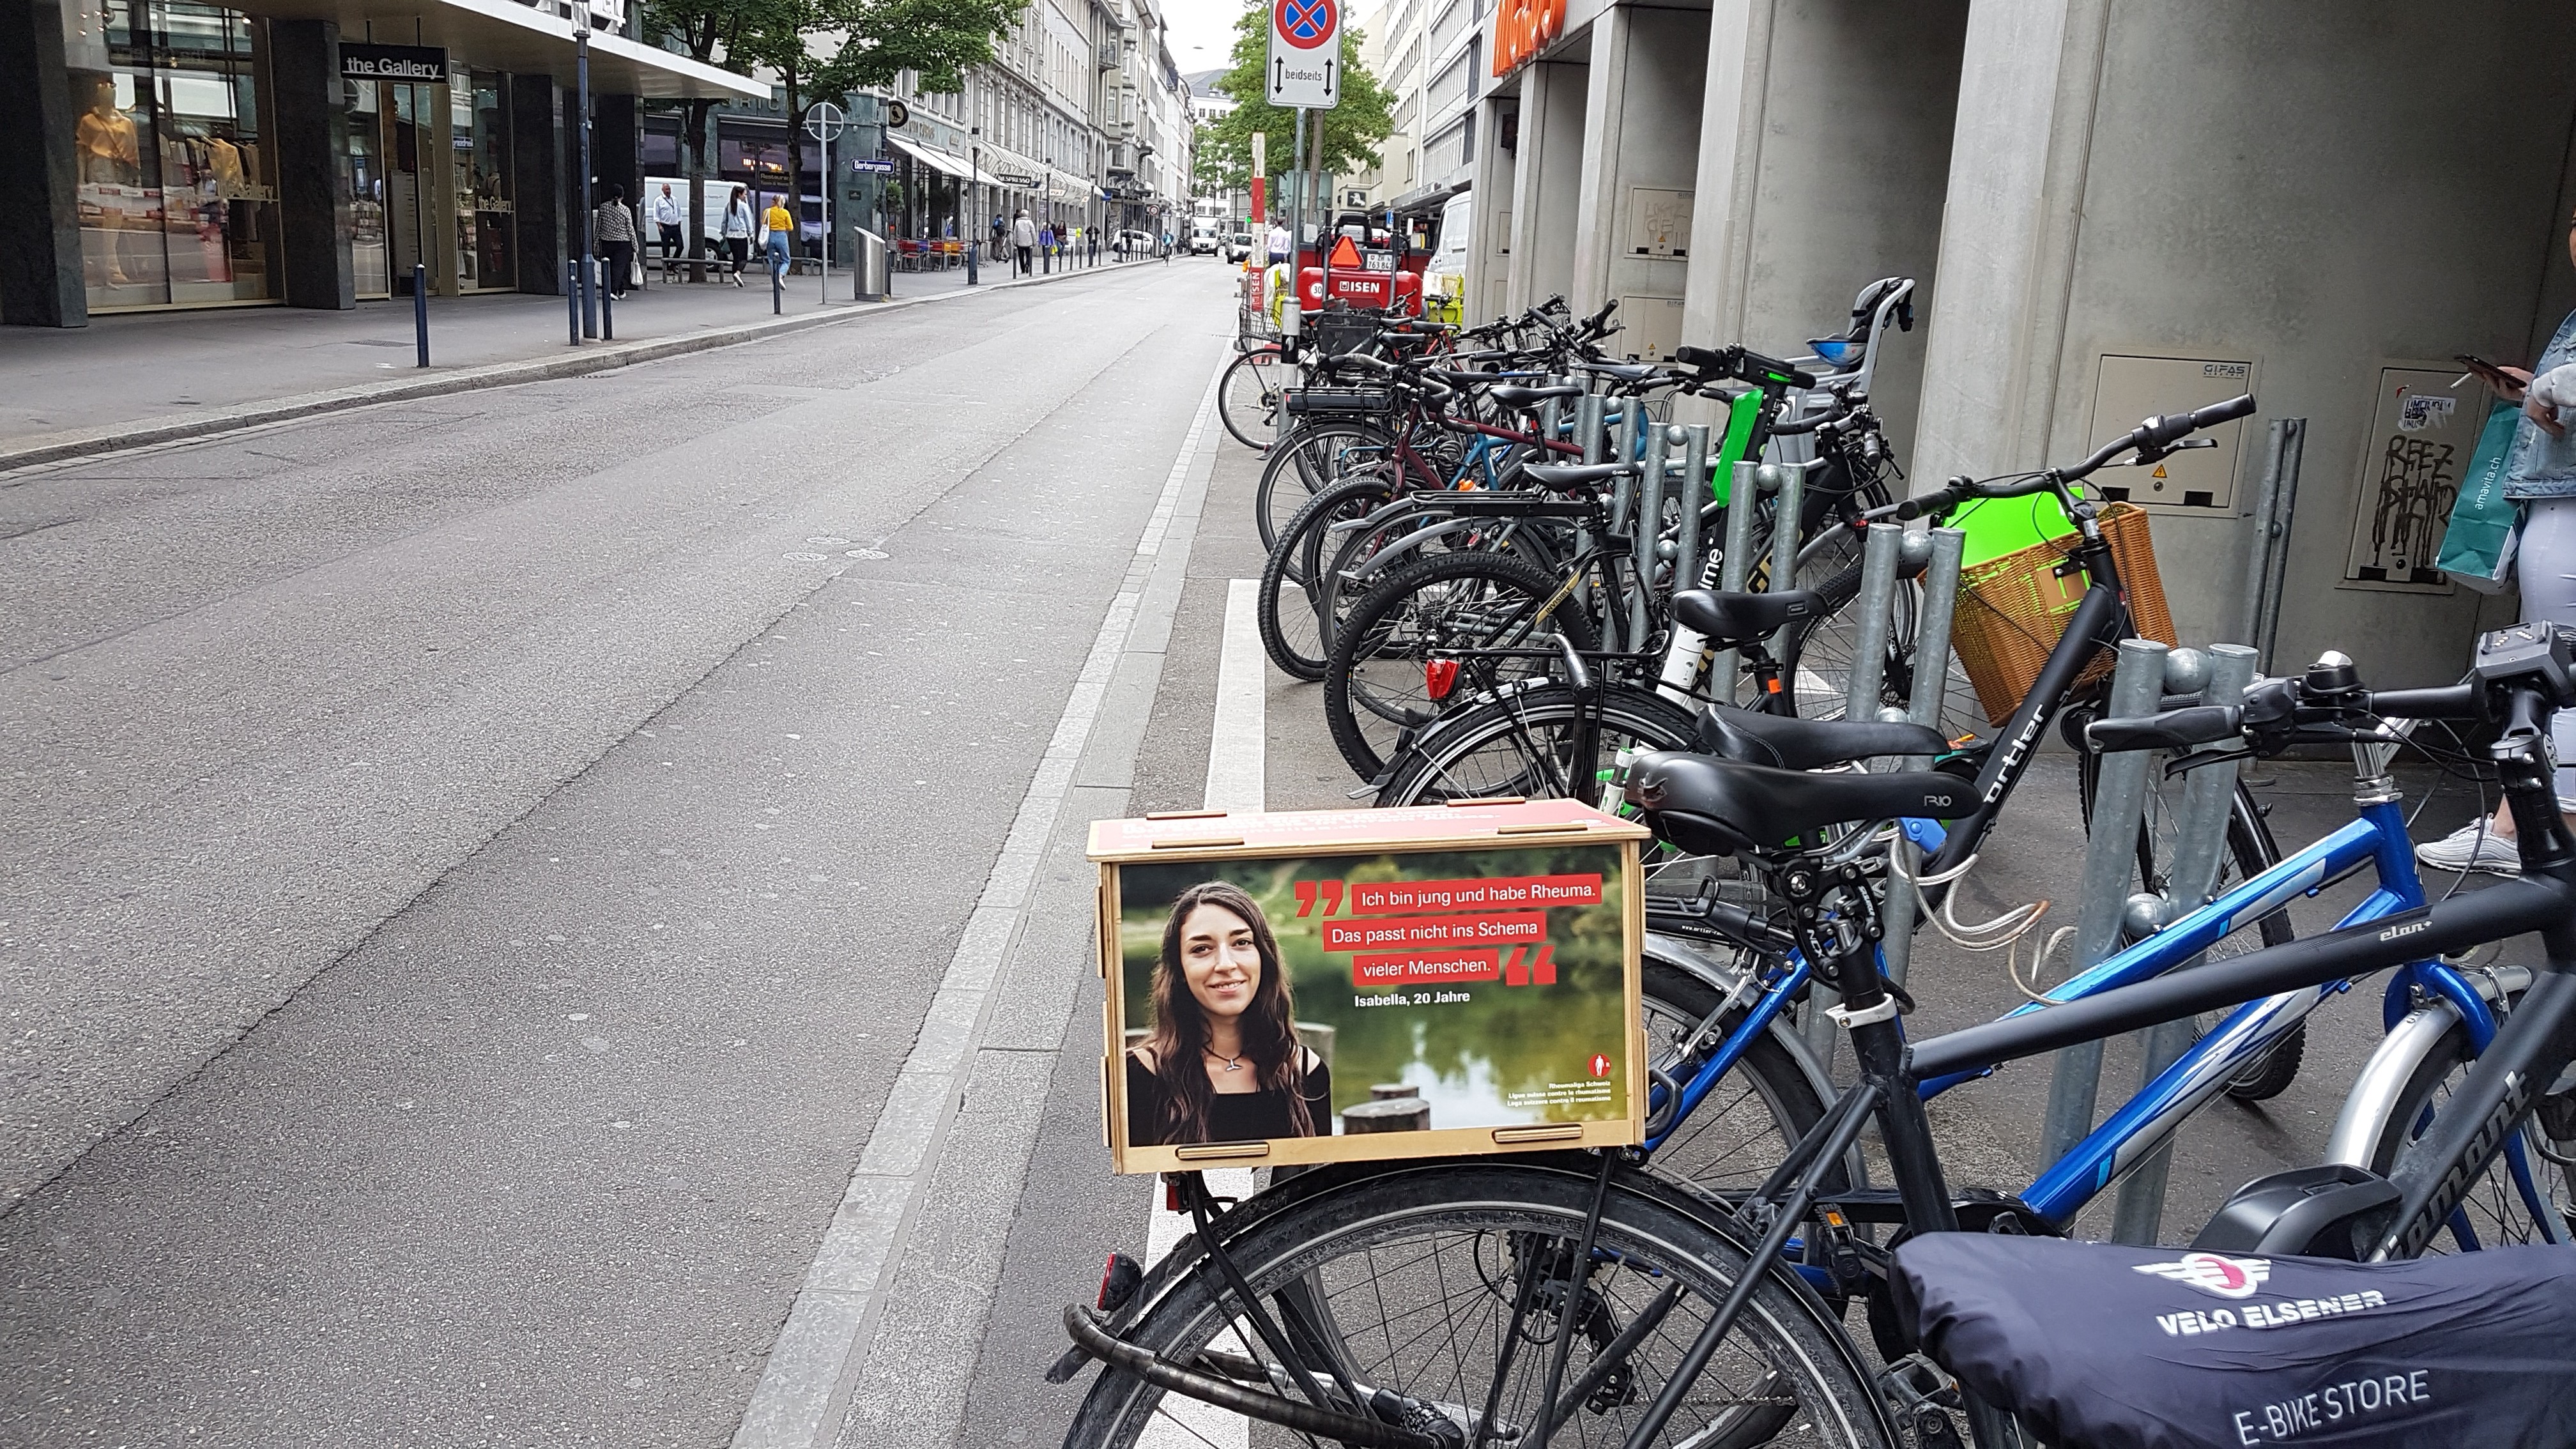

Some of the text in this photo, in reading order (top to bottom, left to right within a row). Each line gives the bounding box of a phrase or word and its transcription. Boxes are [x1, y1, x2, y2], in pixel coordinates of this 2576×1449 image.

[346, 57, 439, 80] the Gallery
[1285, 68, 1322, 81] beidseits
[854, 160, 891, 172] Gerbergasse
[478, 195, 489, 210] the
[1314, 286, 1322, 294] 30
[1351, 281, 1380, 293] ISEN
[2204, 365, 2245, 374] GIFAS
[2475, 456, 2502, 510] amavita.ch
[1698, 548, 1724, 590] ime
[1545, 585, 1572, 614] INVISIBLE
[1983, 704, 2044, 804] ortler
[1924, 795, 1952, 807] RIO
[1361, 884, 1596, 907] Ich bin jung und habe Rheuma.
[1332, 921, 1538, 946] Das passt nicht ins Schema
[1806, 928, 1823, 958] NCX
[1363, 958, 1491, 977] vieler Menschen.
[1354, 991, 1471, 1007] Isabella, 20 Jahre
[1549, 1081, 1585, 1089] Rheumaliga
[2156, 1289, 2388, 1337] VELO ELSENER
[2233, 1369, 2431, 1446] E-BIKE STORE
